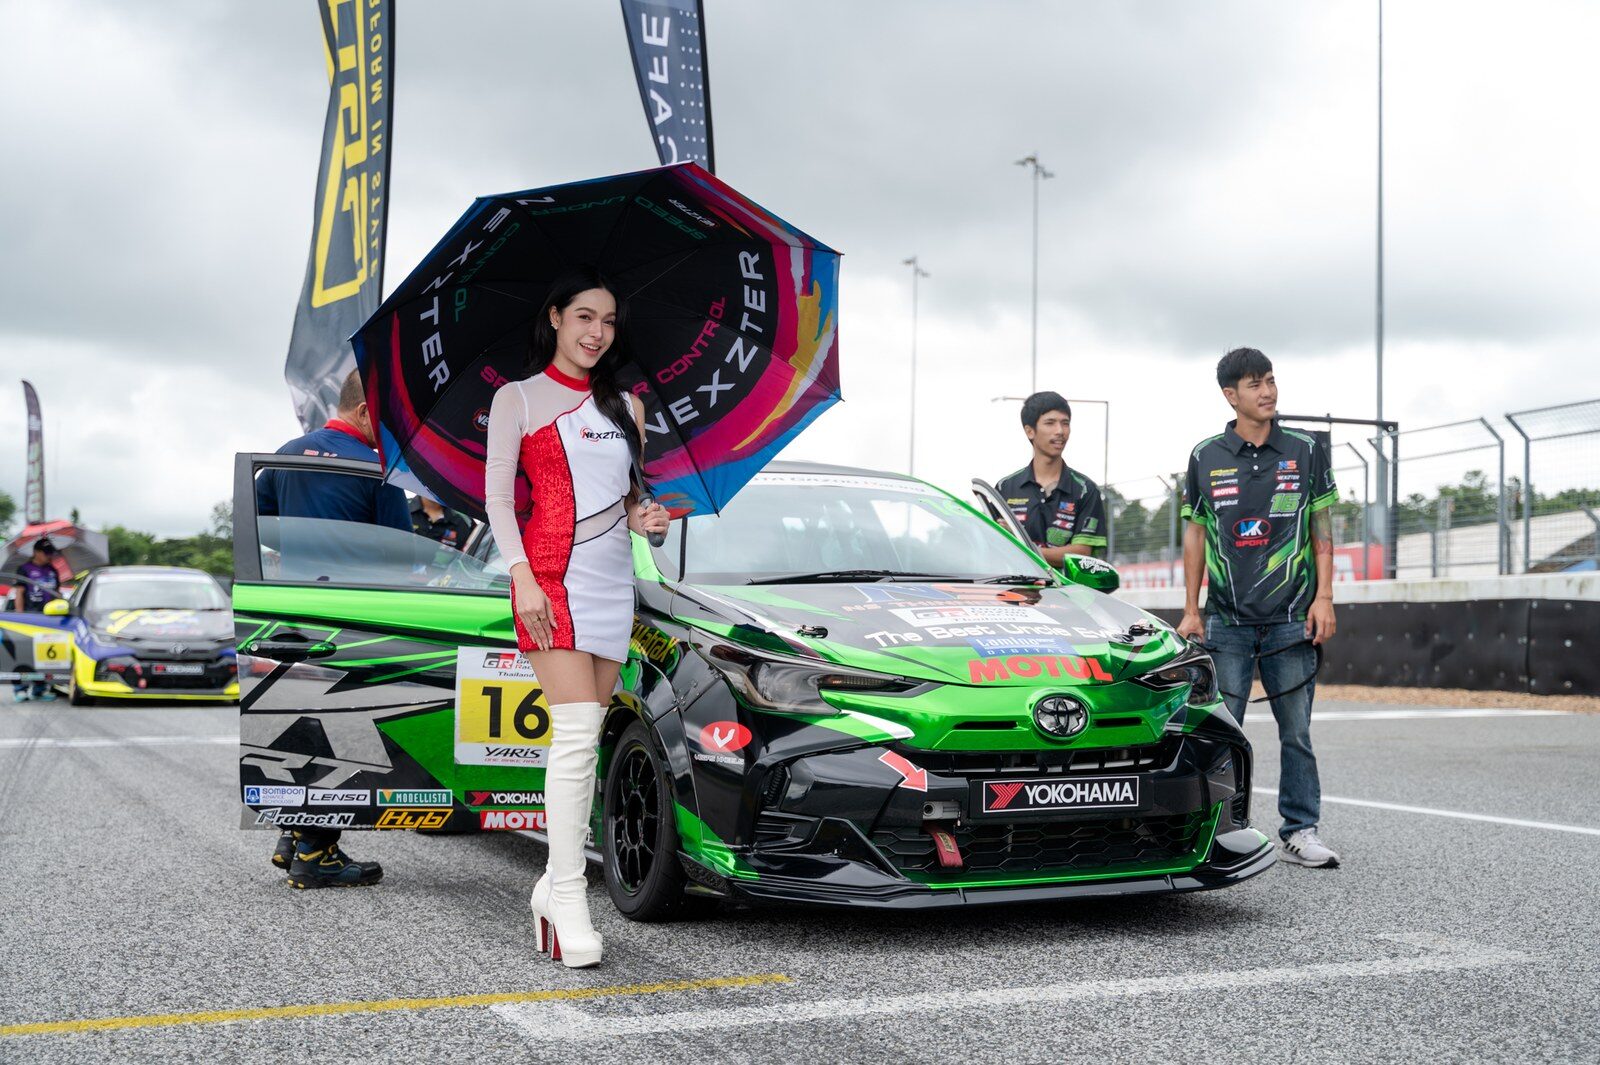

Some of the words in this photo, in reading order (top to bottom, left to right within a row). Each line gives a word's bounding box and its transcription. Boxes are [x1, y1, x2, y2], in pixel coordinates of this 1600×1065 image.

[656, 297, 727, 384] CONTROL
[1235, 538, 1269, 547] SPORT
[864, 630, 923, 647] The
[925, 624, 998, 640] Best
[995, 623, 1071, 638] Uncle
[46, 644, 57, 660] 6
[968, 655, 1114, 683] MOTUL
[482, 686, 550, 739] 16
[310, 793, 368, 802] LENSO
[396, 791, 447, 803] MODELLISTA
[491, 792, 546, 804] YOKOHAM
[1024, 781, 1135, 805] YOKOHAMA
[483, 811, 548, 829] MOTU
